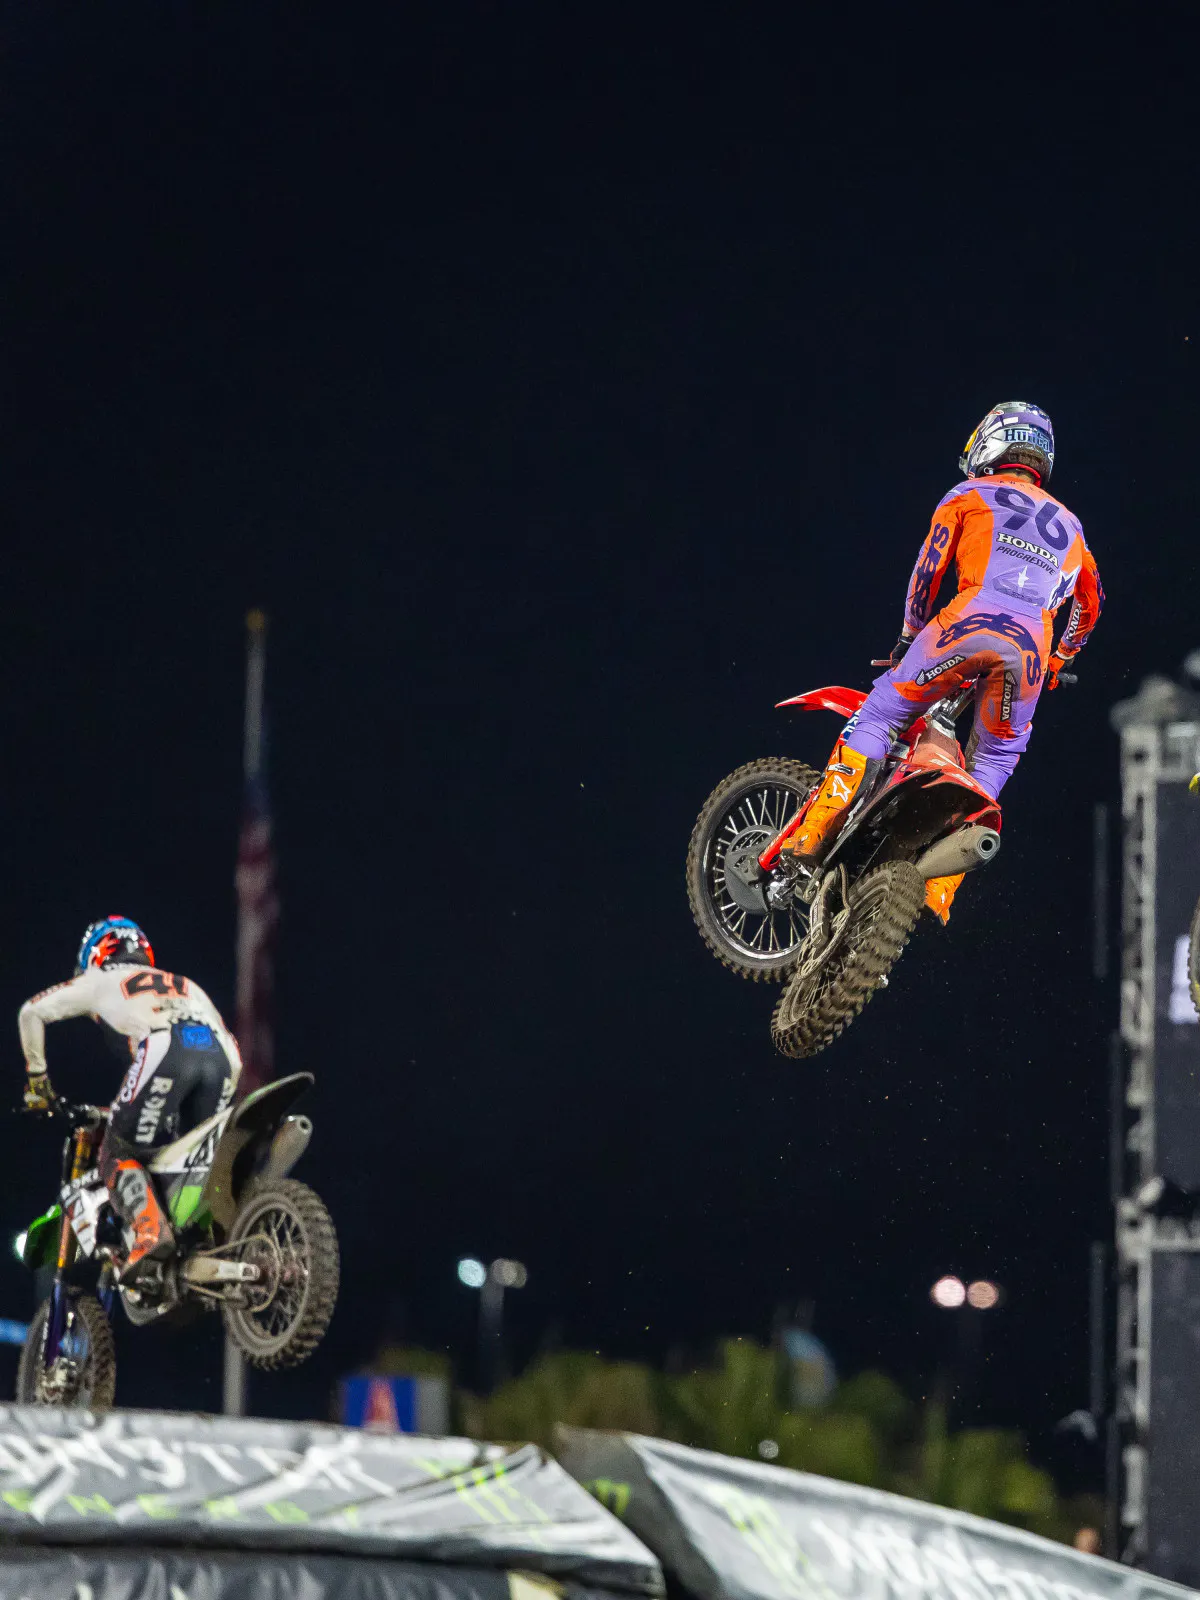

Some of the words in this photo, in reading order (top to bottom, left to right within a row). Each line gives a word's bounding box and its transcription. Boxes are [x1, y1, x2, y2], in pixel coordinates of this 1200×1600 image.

[994, 487, 1068, 551] 96
[996, 545, 1057, 576] PROGRESSIVE
[997, 531, 1060, 569] HONDA
[925, 654, 966, 681] HONDA
[1001, 684, 1013, 721] HONDA
